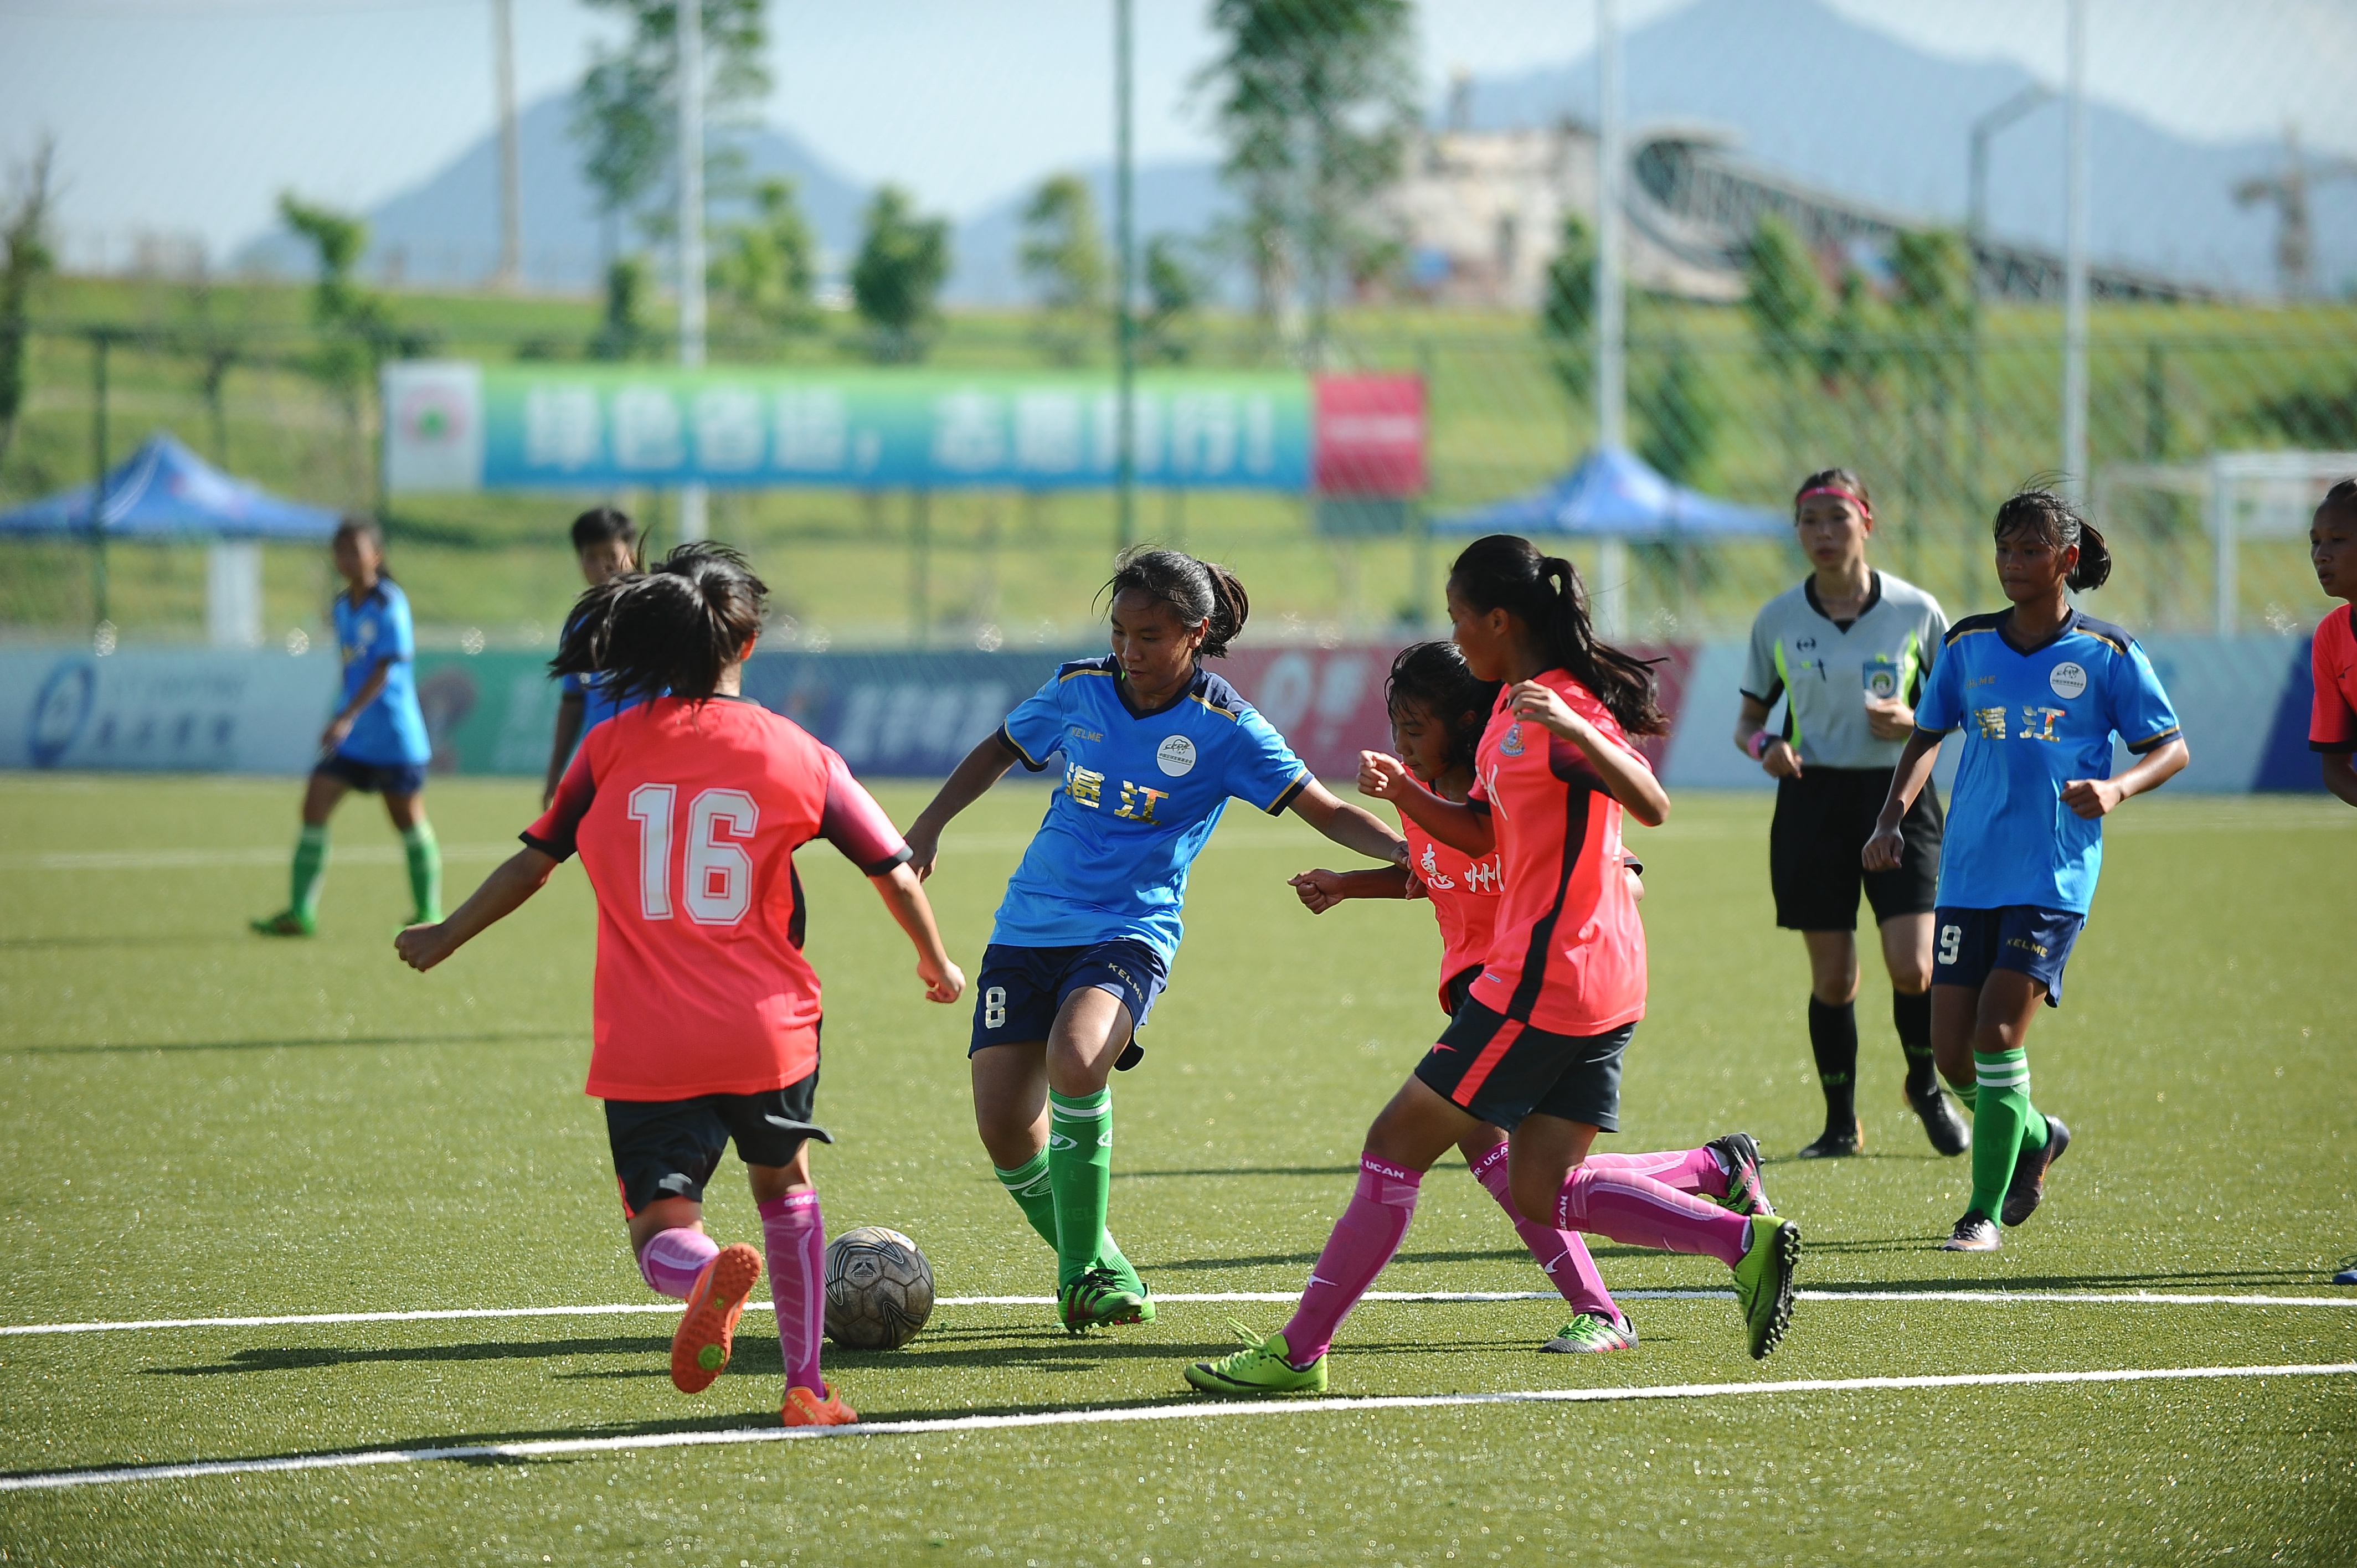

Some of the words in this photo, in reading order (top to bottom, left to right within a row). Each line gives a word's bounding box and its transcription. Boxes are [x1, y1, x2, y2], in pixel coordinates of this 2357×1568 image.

[1072, 726, 1104, 743] KELME
[1064, 761, 1169, 826] 湛江
[627, 782, 760, 926] 16
[1420, 843, 1505, 893] 惠州
[1938, 925, 1962, 965] 9
[2006, 938, 2048, 958] KELME
[1108, 962, 1144, 1004] KELME
[985, 986, 1006, 1029] 8
[1365, 1160, 1405, 1180] UCAN
